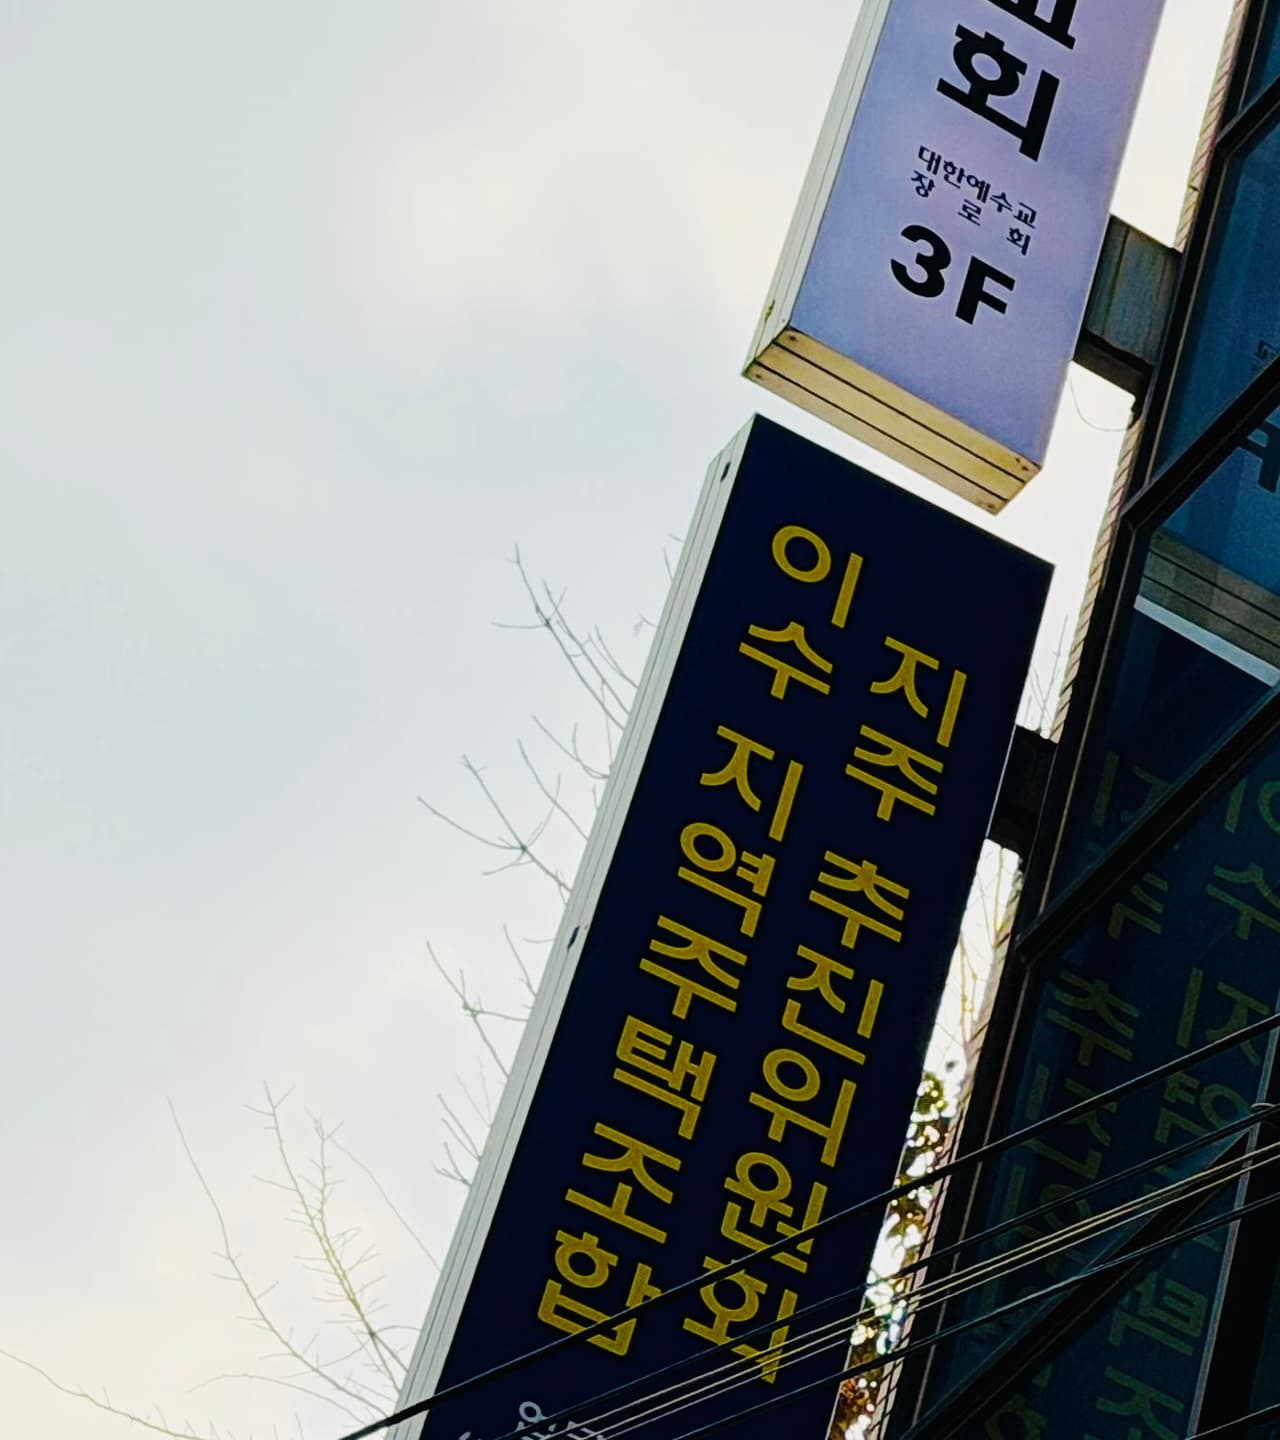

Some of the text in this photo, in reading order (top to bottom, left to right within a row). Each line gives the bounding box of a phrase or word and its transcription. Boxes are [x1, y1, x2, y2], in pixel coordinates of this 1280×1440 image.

[890, 224, 1016, 325] 3F
[917, 145, 1037, 229] 대한예수교
[537, 524, 863, 1356] 이수 지역주택조합
[682, 636, 967, 1384] 지주 추진위원회
